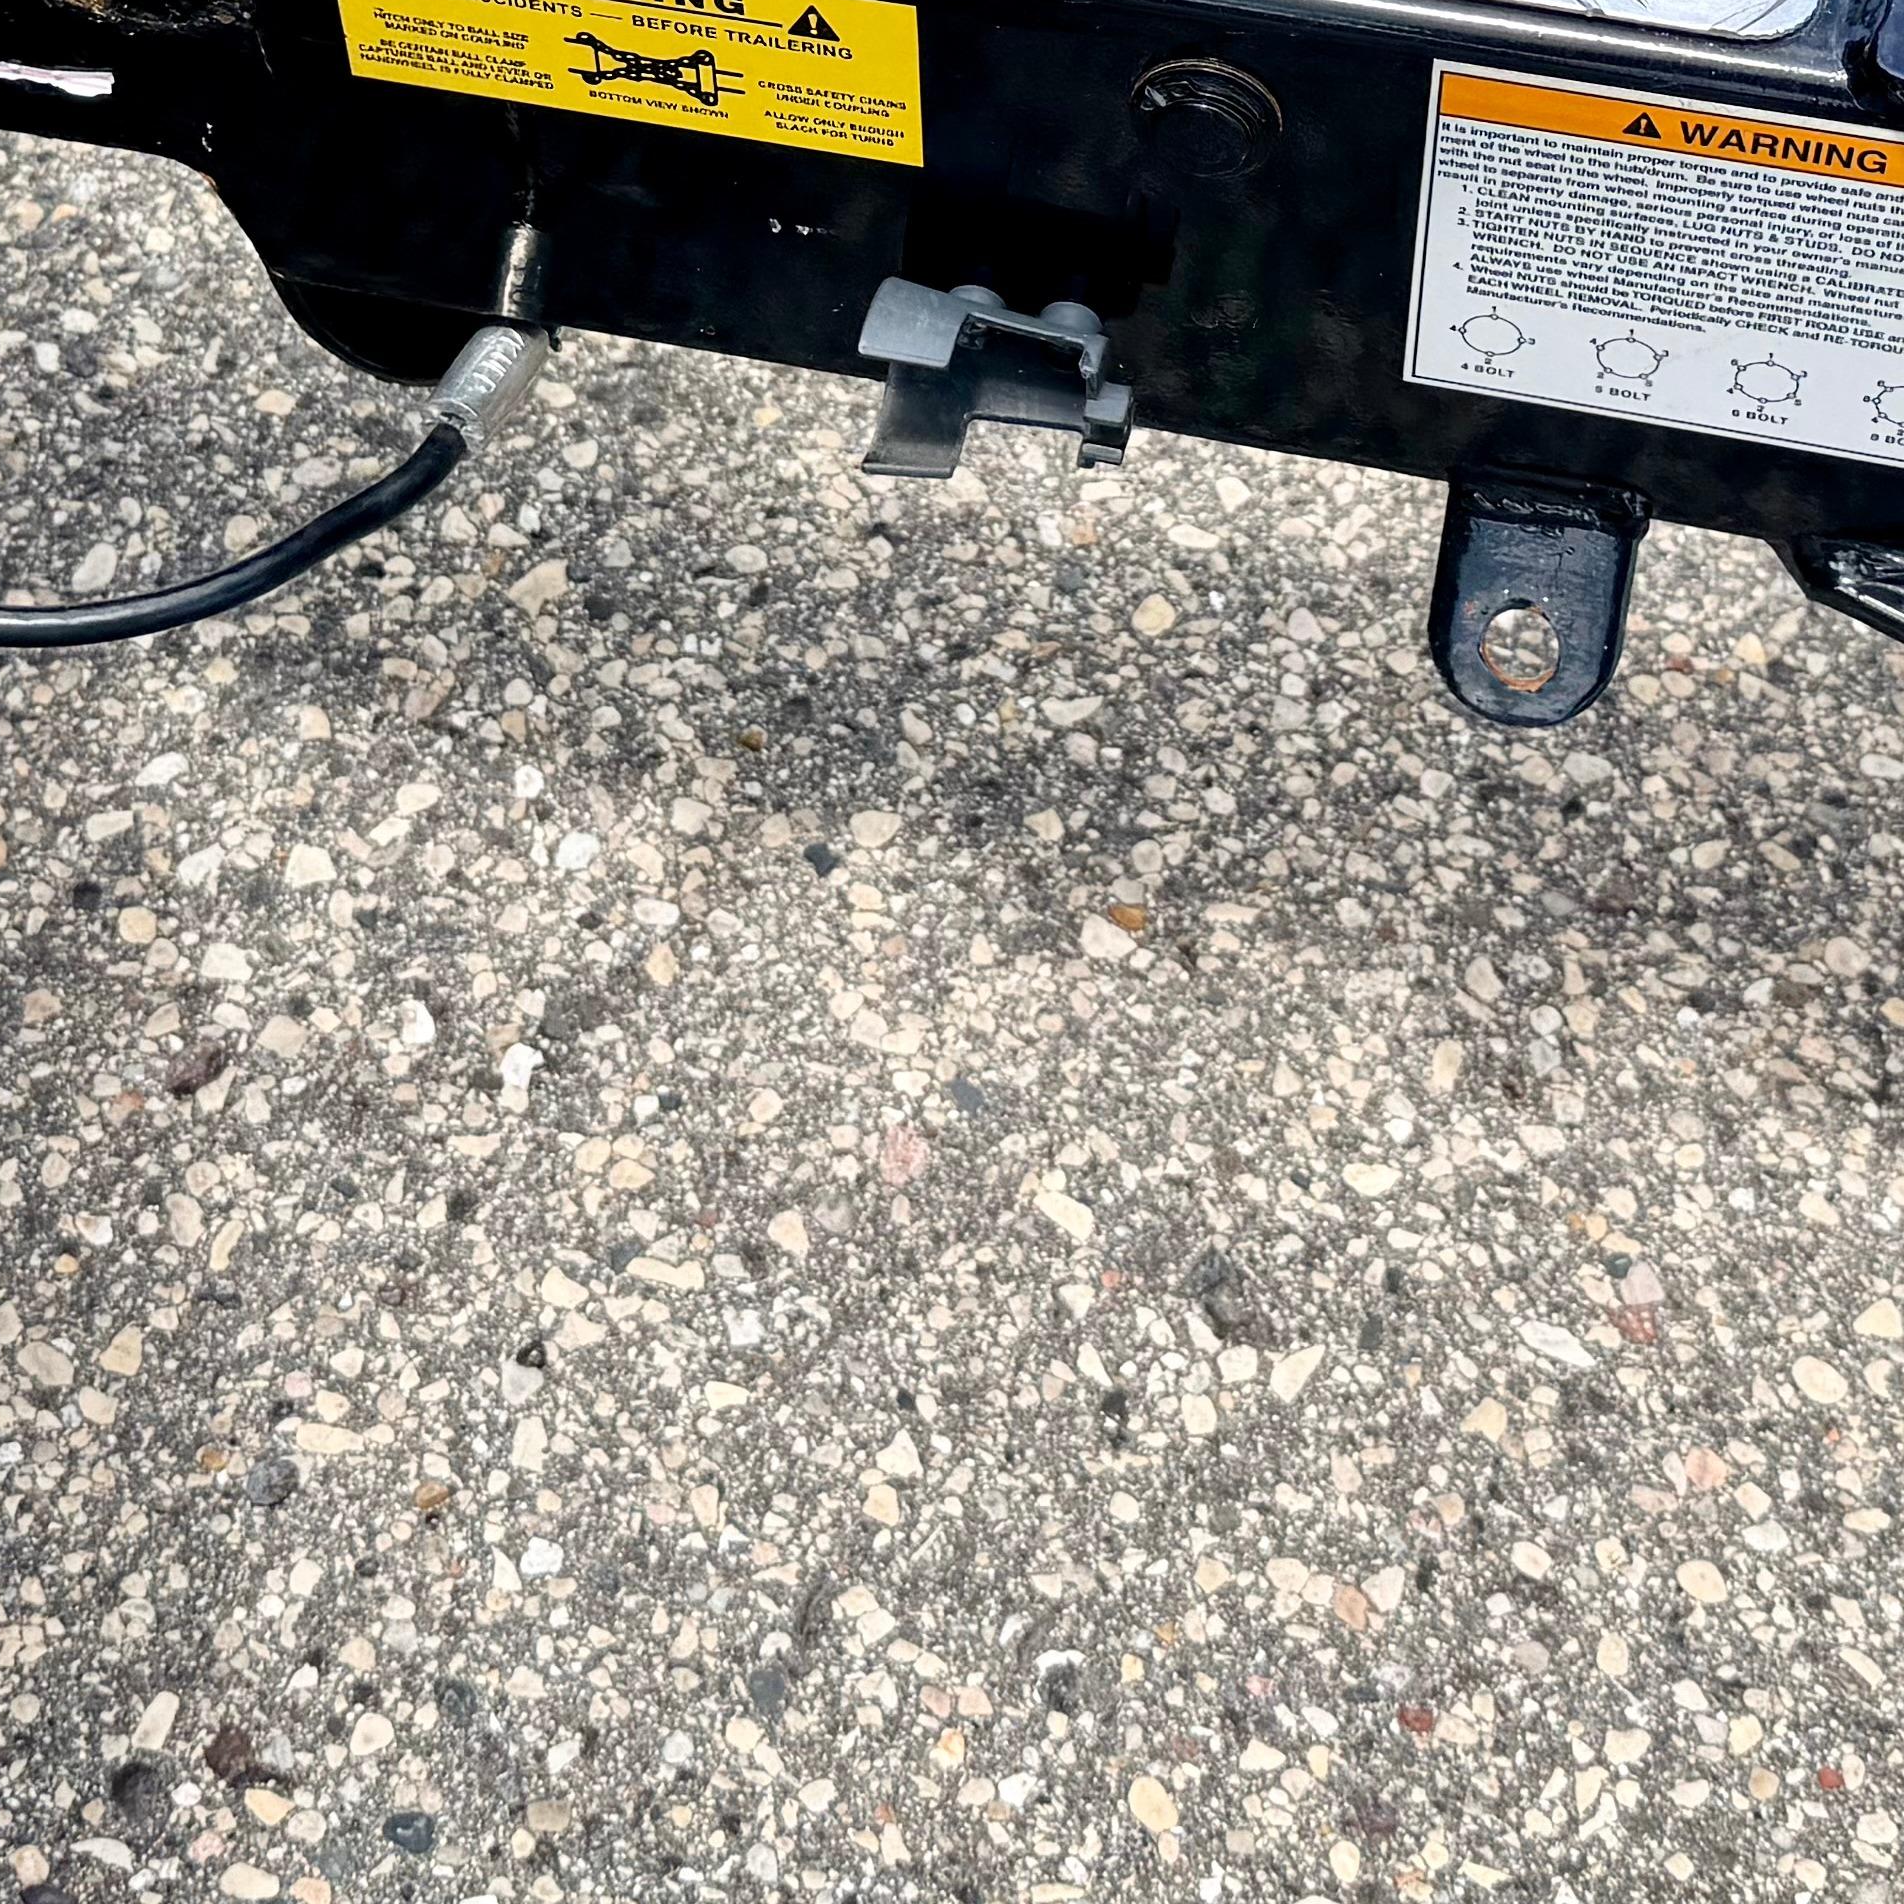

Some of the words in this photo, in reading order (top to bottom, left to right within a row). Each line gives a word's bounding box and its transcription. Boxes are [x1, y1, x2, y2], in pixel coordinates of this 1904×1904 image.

[446, 22, 465, 33] TO
[631, 14, 718, 40] BEFORE
[723, 28, 853, 60] TRAILERING
[533, 71, 553, 82] OR
[645, 98, 678, 111] VIEW
[1439, 135, 1477, 149] ment
[1479, 140, 1496, 151] of
[1496, 142, 1521, 155] the
[1521, 145, 1567, 163] wheel
[1568, 153, 1585, 166] to
[1587, 156, 1611, 170] the
[1695, 173, 1717, 186] Be
[1719, 179, 1753, 192] sure
[1755, 183, 1774, 195] to
[1774, 187, 1803, 200] use
[1805, 192, 1851, 208] wheel
[1852, 200, 1887, 214] nuts
[1469, 125, 1540, 147] important
[1543, 137, 1559, 149] to
[1560, 141, 1626, 160] maintain
[1626, 152, 1678, 168] proper
[1678, 159, 1728, 176] torque
[1730, 169, 1760, 182] and
[1762, 172, 1778, 184] to
[1780, 177, 1838, 194] provide
[1840, 186, 1873, 199] safe
[1679, 119, 1888, 176] WARNING
[1437, 157, 1481, 172] wheel
[1482, 163, 1498, 175] to
[1500, 167, 1563, 186] separate
[1565, 176, 1601, 192] from
[1603, 184, 1649, 200] wheel
[1652, 192, 1726, 213] mounting
[1728, 205, 1788, 221] surface
[1790, 214, 1843, 231] during
[1437, 169, 1479, 184] result
[1482, 174, 1497, 187] in
[1500, 179, 1565, 198] property
[1635, 201, 1693, 218] serious
[1695, 211, 1764, 230] personal
[1817, 230, 1836, 241] or
[1838, 232, 1872, 246] loss
[1875, 240, 1894, 250] of
[1439, 146, 1472, 159] with
[1472, 150, 1496, 163] the
[1497, 155, 1523, 167] nut
[1524, 160, 1557, 173] seat
[1558, 163, 1573, 176] in
[1575, 167, 1600, 180] the
[1601, 172, 1649, 189] wheel.
[1655, 179, 1736, 202] Improperly
[1738, 193, 1797, 211] torqued
[1798, 203, 1844, 218] wheel
[1845, 211, 1880, 224] nuts
[1474, 208, 1526, 225] START
[1527, 216, 1573, 233] NUTS
[1599, 228, 1647, 245] HAND
[1649, 237, 1667, 248] to
[1667, 241, 1727, 259] prevent
[1729, 251, 1773, 266] cross
[1775, 257, 1853, 279] threading.
[1476, 185, 1533, 204] CLEAN
[1533, 196, 1606, 217] mounting
[1719, 225, 1764, 241] NUTS
[1850, 246, 1877, 259] DO
[1460, 362, 1469, 371] 4
[1473, 364, 1515, 379] BOLT
[1608, 387, 1652, 402] BOLT
[1745, 410, 1789, 426] BOLT
